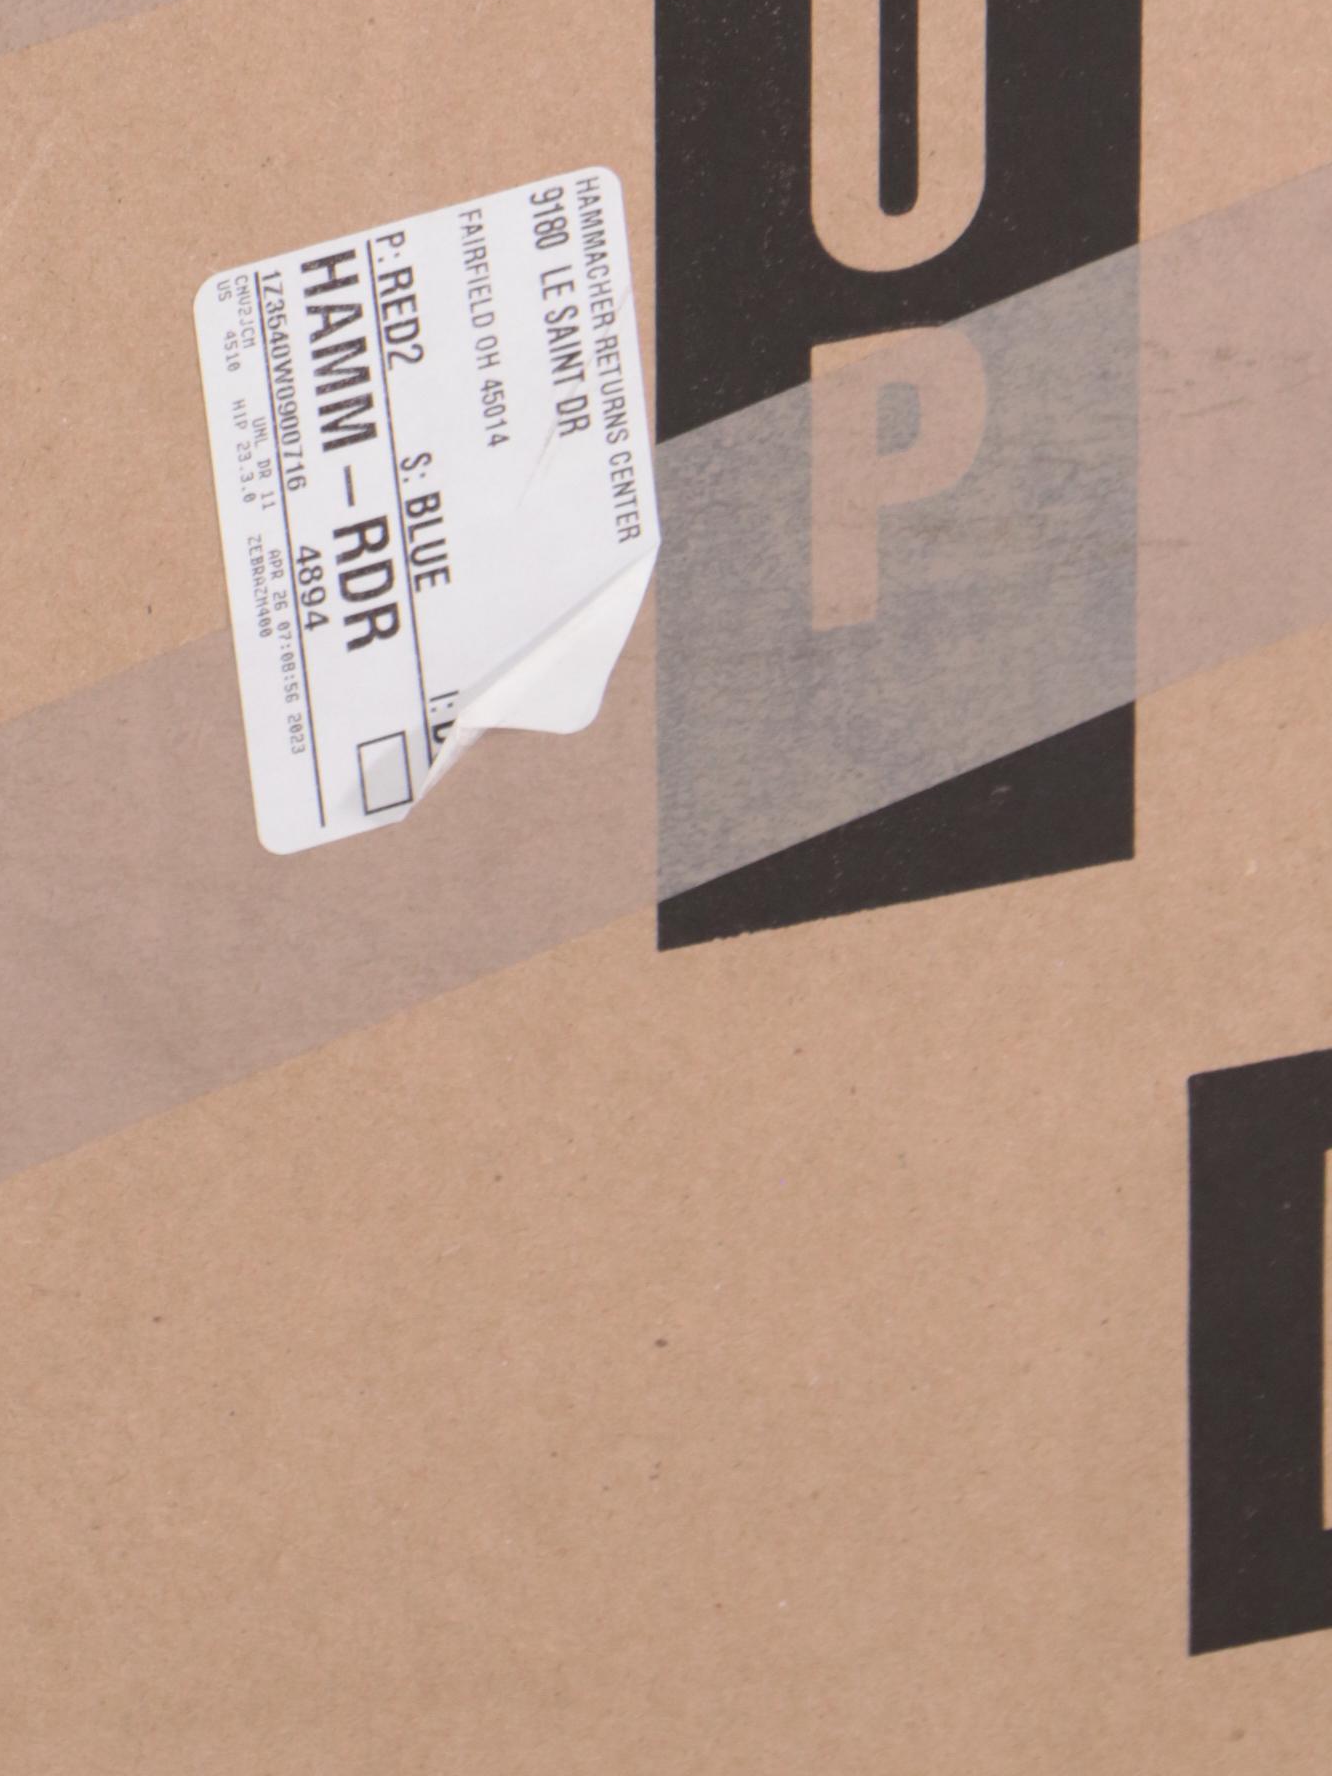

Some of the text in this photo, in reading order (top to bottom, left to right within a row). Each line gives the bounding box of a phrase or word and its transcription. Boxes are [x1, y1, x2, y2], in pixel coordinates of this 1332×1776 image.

[216, 280, 231, 302] US
[457, 209, 509, 447] FAIRFIELD OH 45014
[528, 188, 590, 438] 9180 LE SAINT DR
[222, 331, 240, 372] 4510
[300, 249, 377, 452] HAMM
[575, 176, 641, 543] HAMMACHER RETURNS CENTER
[255, 459, 272, 478] DR
[261, 270, 329, 631] 1Z3540W0900716 4894
[399, 452, 432, 482] S:
[260, 491, 275, 510] 11
[404, 491, 450, 593] BLUE
[266, 549, 284, 580] APR
[331, 516, 400, 652] RDR
[272, 591, 288, 611] 26
[287, 714, 305, 755] 2023
